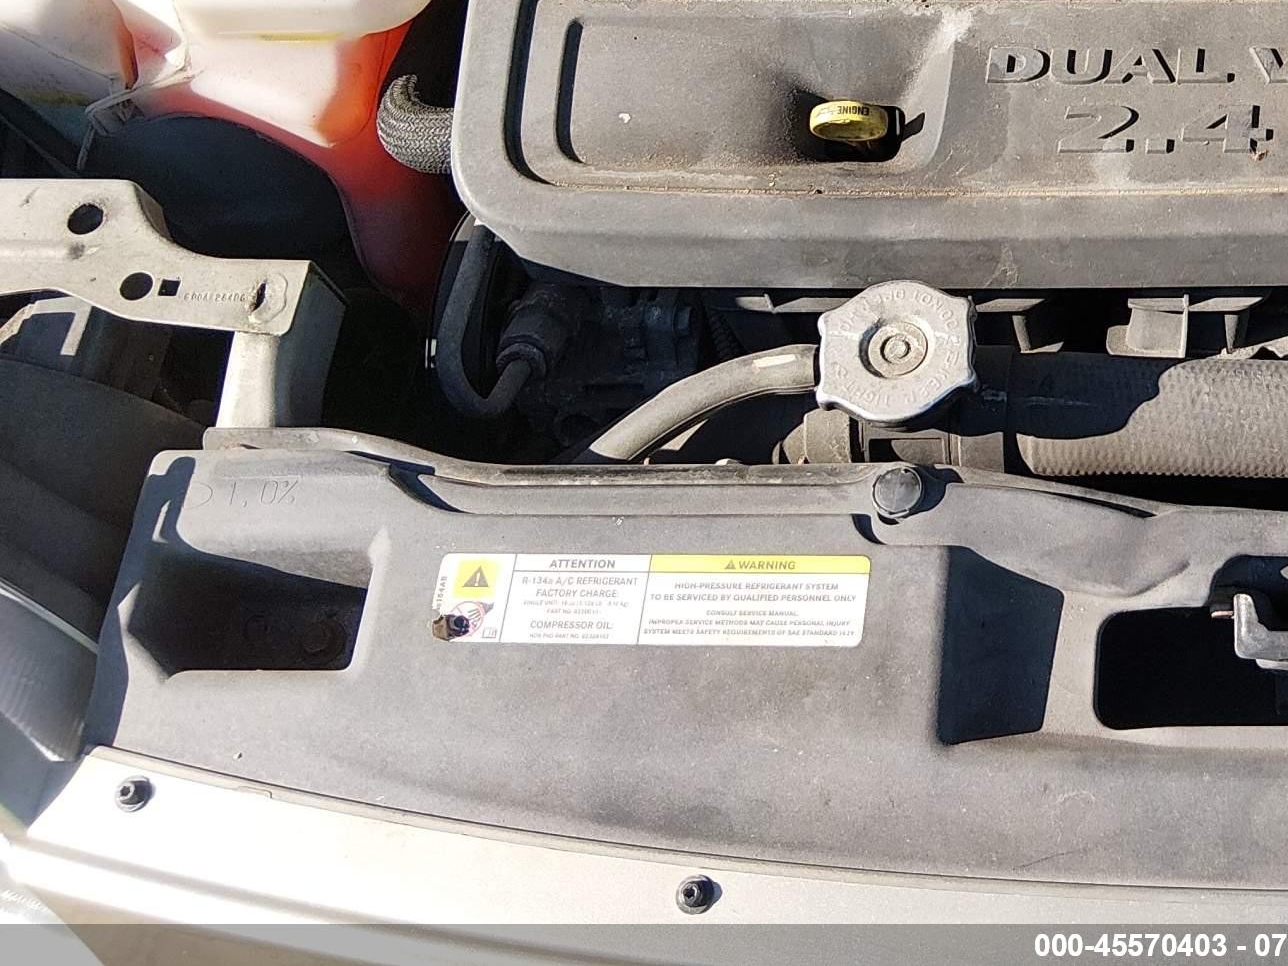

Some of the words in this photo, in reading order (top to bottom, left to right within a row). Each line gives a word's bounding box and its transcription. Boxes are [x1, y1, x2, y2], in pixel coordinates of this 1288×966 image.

[985, 46, 1236, 85] DUAL
[837, 105, 869, 116] ENGINE
[549, 559, 616, 569] ATTENTION
[738, 560, 796, 570] WARNING
[555, 576, 574, 587] A/C
[576, 577, 639, 586] REFRIGERANT
[674, 582, 743, 590] HIGH-PRESSURE
[745, 582, 803, 590] REFRIGERANT
[535, 588, 578, 598] FACTORY
[650, 593, 662, 601] TO
[663, 593, 674, 601] BE
[676, 593, 718, 602] SERVICED
[720, 593, 731, 602] BY
[733, 594, 779, 602] QUALIFIED
[781, 594, 832, 602] PERSONNEL
[833, 594, 857, 602] ONLY
[530, 620, 594, 630] COMPRESSOR
[685, 618, 713, 626] SERVICE
